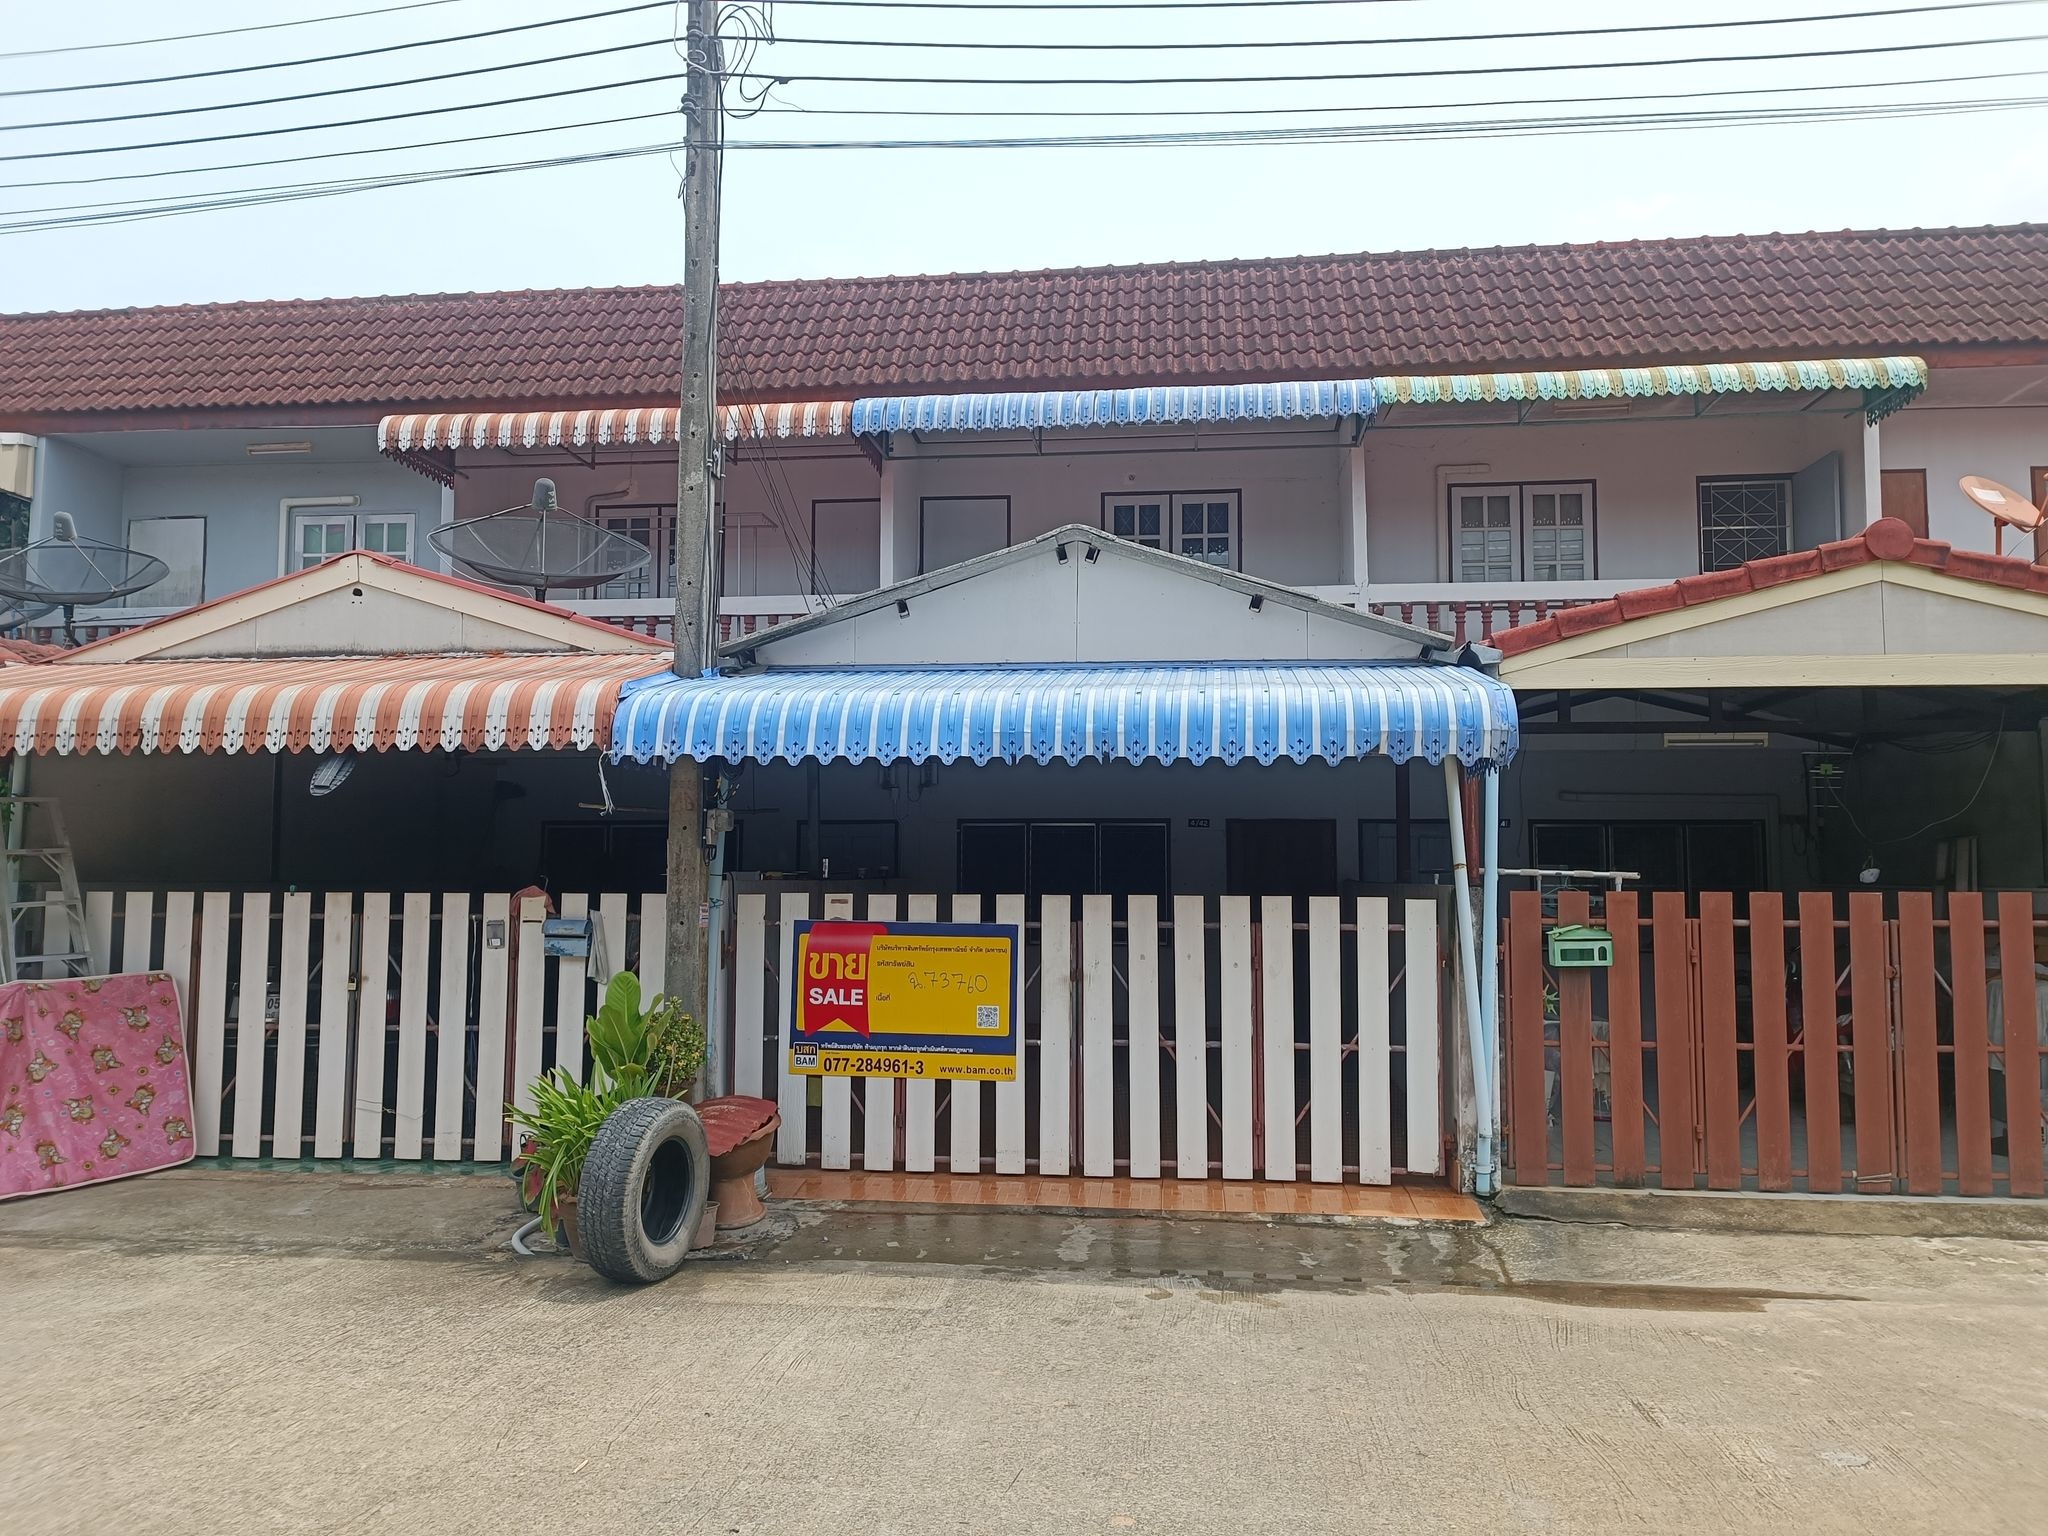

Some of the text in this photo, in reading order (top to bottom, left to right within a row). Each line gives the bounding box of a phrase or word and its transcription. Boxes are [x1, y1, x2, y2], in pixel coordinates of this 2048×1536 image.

[969, 946, 984, 954] จำกัด
[985, 947, 1008, 955] (มหาชน)
[809, 952, 867, 980] ขาย
[876, 959, 915, 968] รหัสทรัพย์สิน
[808, 987, 864, 1006] SALE
[875, 992, 891, 1002] เนื้อที่
[796, 1045, 815, 1055] บสก
[795, 1056, 816, 1066] BAM
[823, 1057, 924, 1075] 077-284961-3
[939, 1065, 1013, 1076] www.bam.co.th
